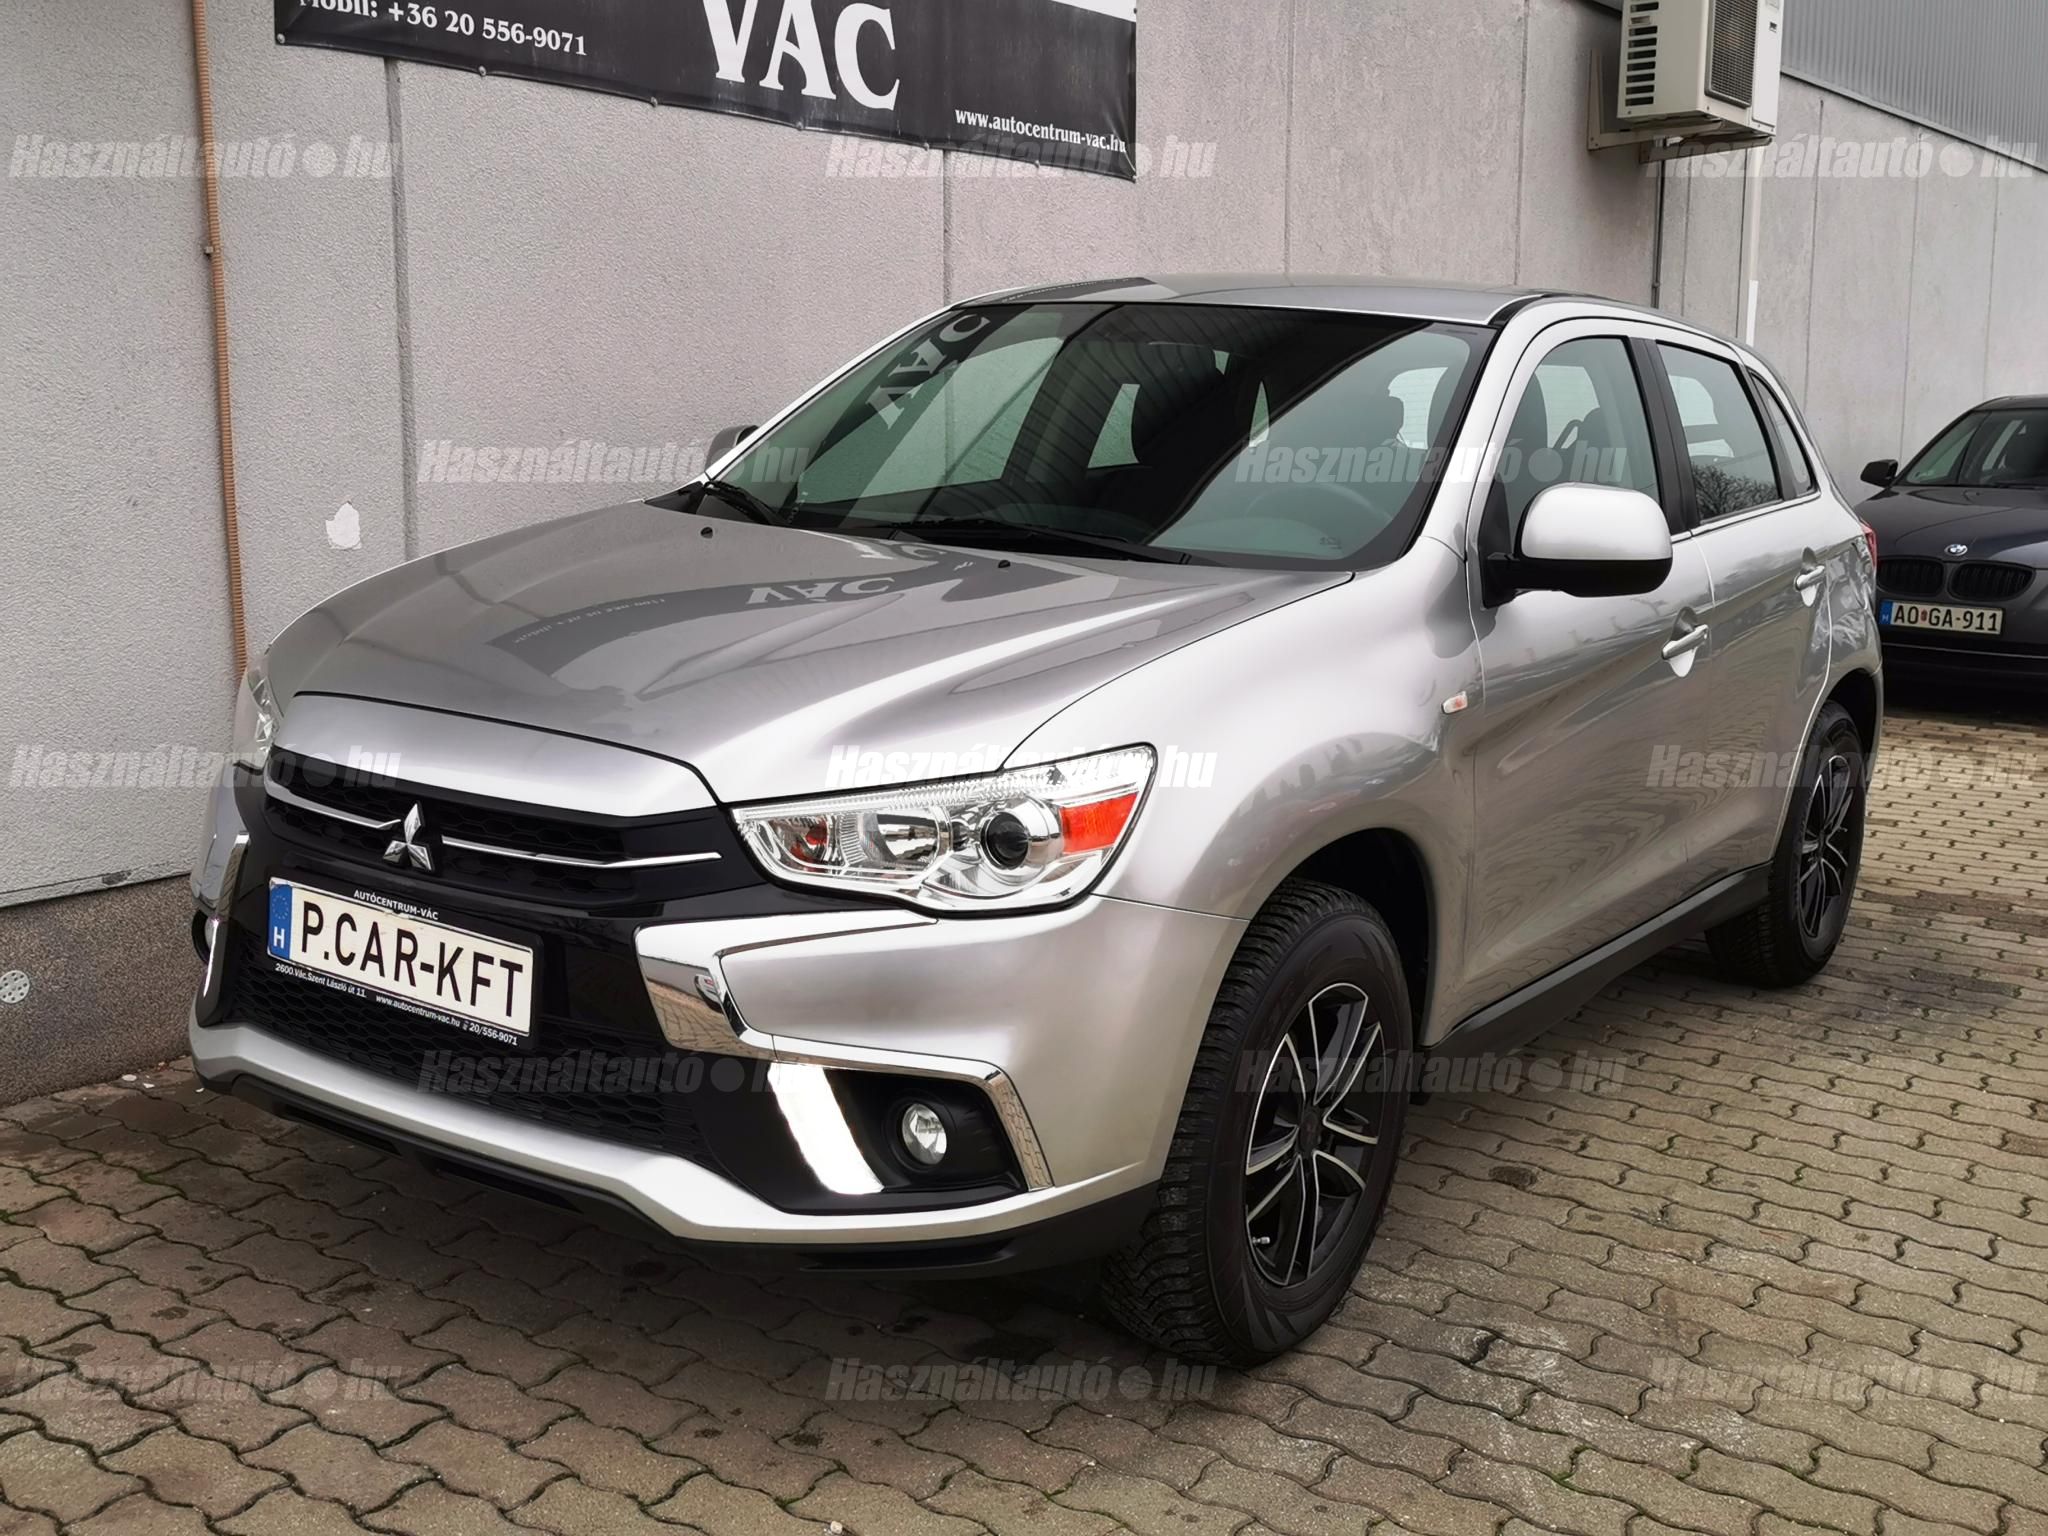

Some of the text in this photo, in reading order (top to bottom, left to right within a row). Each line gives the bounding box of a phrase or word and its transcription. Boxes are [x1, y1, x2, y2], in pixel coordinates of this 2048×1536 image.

[388, 2, 438, 29] +36
[444, 10, 475, 36] 20
[482, 17, 587, 56] 556-9071
[954, 110, 1126, 153] www.autocentrum-vac.hu
[353, 889, 439, 920] AUTÓCENTRUM-VÁC
[273, 900, 524, 1018] H P.CAR-KFT
[375, 995, 461, 1028] www.autocentrum-vac.hu
[469, 1022, 518, 1046] 20/556-9071
